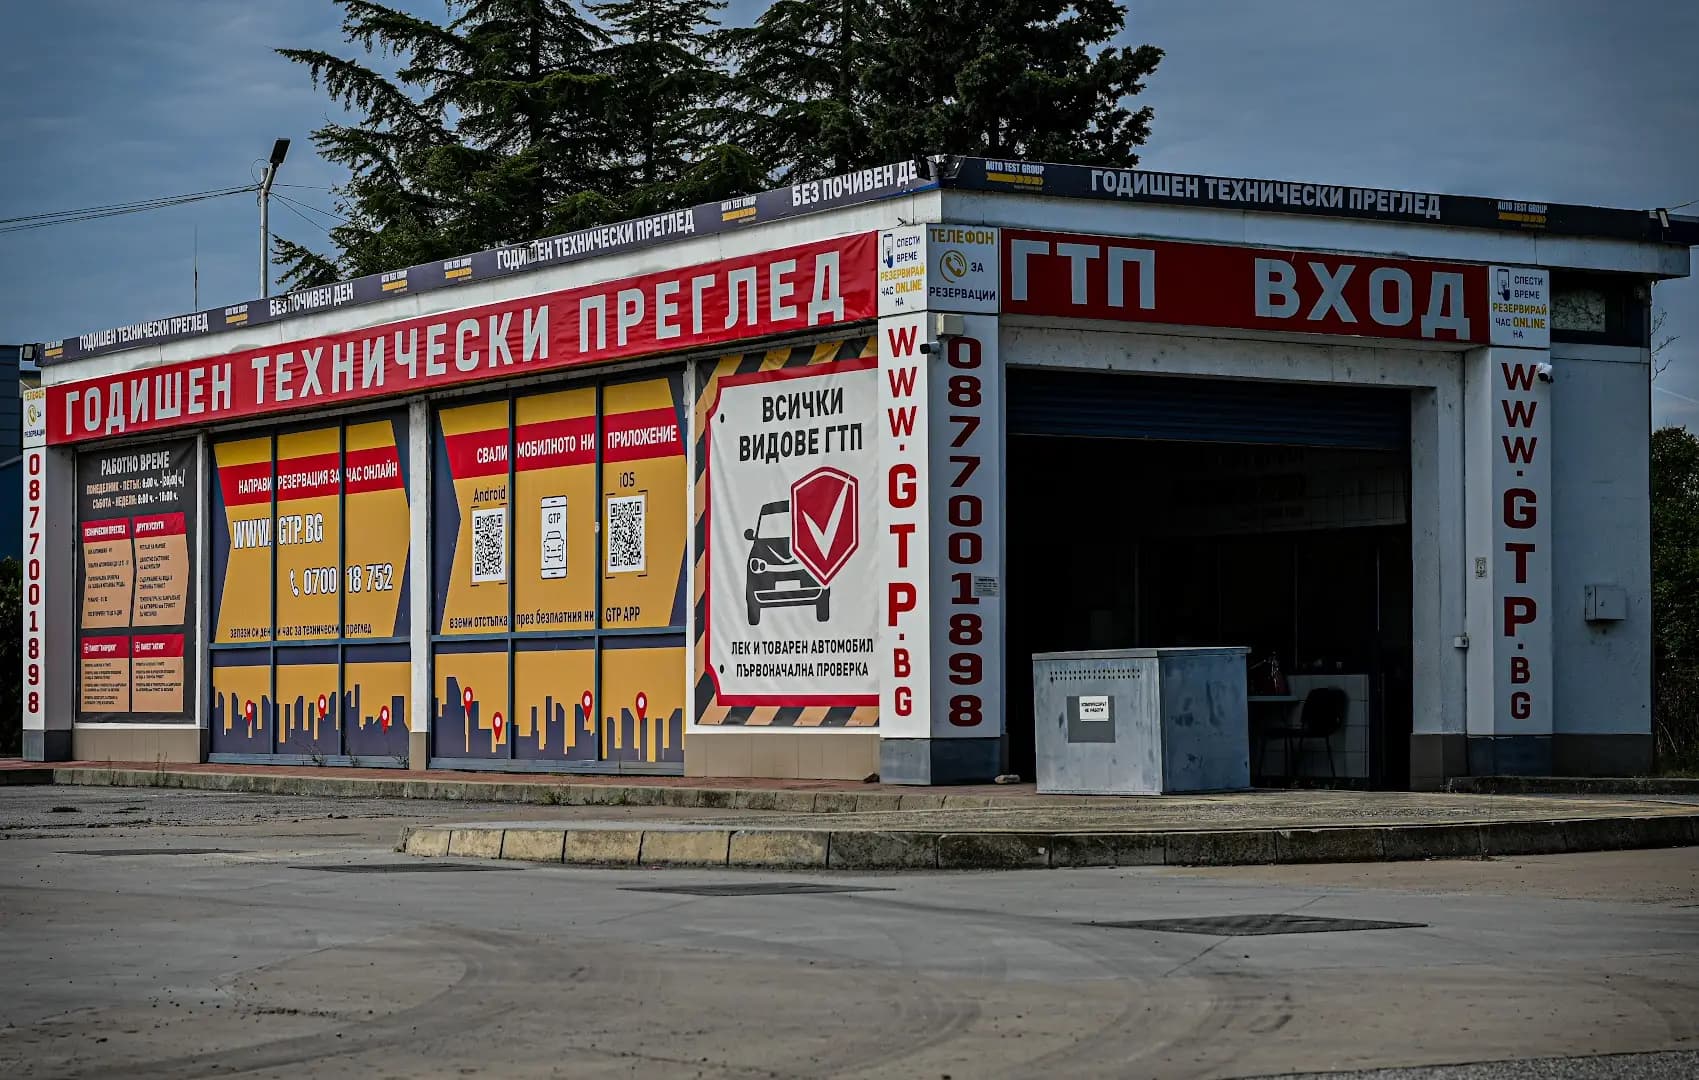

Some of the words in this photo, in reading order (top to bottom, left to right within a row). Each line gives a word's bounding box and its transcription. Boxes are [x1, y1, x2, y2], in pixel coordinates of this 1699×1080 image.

[985, 161, 1003, 172] AUTO
[1004, 162, 1020, 173] TEST
[1021, 164, 1044, 176] GROUP
[792, 182, 819, 207] БЕЗ
[822, 167, 893, 201] ПОЧИВЕН
[896, 159, 918, 188] ДЕ
[1091, 169, 1198, 199] ГОДИШЕН
[1205, 178, 1343, 210] ТЕХНИЧЕСКИ
[1348, 189, 1441, 220] ПРЕГЛЕД
[1497, 200, 1513, 211] AUTO
[1514, 201, 1527, 212] TEST
[1528, 203, 1548, 214] GROUP
[496, 241, 553, 271] ГОДИШЕН
[554, 222, 634, 258] ТЕХНИЧЕСКИ
[636, 209, 695, 241] ПРЕГЛЕД
[896, 235, 921, 248] СПЕСТИ
[930, 228, 994, 245] ТЕЛЕФОН
[896, 251, 918, 263] ВРЕМЕ
[880, 263, 925, 282] РЕЗЕРВИРАЙ
[970, 262, 984, 273] ЗА
[881, 286, 894, 297] ЧАС
[895, 279, 922, 294] ONLINE
[1011, 239, 1155, 310] ГТП
[1255, 257, 1470, 340] ВХОД
[1514, 275, 1543, 286] СПЕСТИ
[270, 299, 287, 317] БЕЗ
[287, 287, 331, 313] ПОЧИВЕН
[333, 282, 353, 307] ДЕН
[895, 297, 904, 307] НА
[929, 287, 996, 302] РЕЗЕРВАЦИИ
[1514, 290, 1540, 299] ВРЕМЕ
[1492, 302, 1547, 316] РЕЗЕРВИРАЙ
[79, 328, 116, 351] ГОДИШЕН
[117, 319, 169, 343] ТЕХНИЧЕСКИ
[170, 313, 209, 335] ПРЕГЛЕД
[1495, 317, 1511, 327] ЧАС
[1513, 316, 1546, 329] ONLINE
[65, 362, 232, 435] ГОДИШЕН
[251, 305, 549, 404] ТЕХНИЧЕСКИ
[579, 250, 845, 355] ПРЕГЛЕД
[1513, 330, 1524, 339] НА
[761, 386, 843, 423] ВСИЧКИ
[476, 444, 508, 464] СВАЛИ
[517, 436, 576, 459] МОБИЛНОТО
[580, 432, 595, 451] НИ
[607, 424, 677, 449] ПРИЛОЖЕНИЕ
[739, 426, 819, 464] ВИДОВЕ
[825, 422, 862, 453] ГТП
[101, 455, 138, 476] РАБОТНО
[140, 450, 170, 471] ВРЕМЕ
[238, 476, 272, 494] НАПРАВИ
[277, 469, 328, 490] РЕЗЕРВАЦИЯ
[329, 468, 340, 484] ЗА
[346, 466, 362, 483] ЧАС
[363, 459, 398, 481] ОНЛАЙН
[618, 471, 635, 489] iOS
[473, 484, 506, 503] Android
[547, 512, 561, 524] GTP
[888, 326, 918, 716] WWW.GTP.BG
[947, 336, 983, 727] 0877001898
[1501, 362, 1537, 719] WWW.GTP.BG
[28, 453, 40, 713] 0877001898
[303, 566, 337, 595] 0700
[346, 565, 361, 593] 18
[366, 562, 393, 592] 752
[449, 617, 472, 629] вземи
[474, 615, 508, 628] отстъпка
[516, 613, 534, 628] през
[536, 608, 582, 626] безплатния
[583, 610, 594, 622] ни
[605, 607, 622, 622] GTP
[623, 606, 640, 621] APP
[731, 641, 751, 656] ЛЕК
[753, 640, 760, 655] И
[761, 639, 808, 655] ТОВАРЕН
[811, 638, 874, 654] АВТОМОБИЛ
[736, 663, 814, 678] ПЪРВОНАЧАЛНА
[816, 661, 869, 677] ПРОВЕРКА
